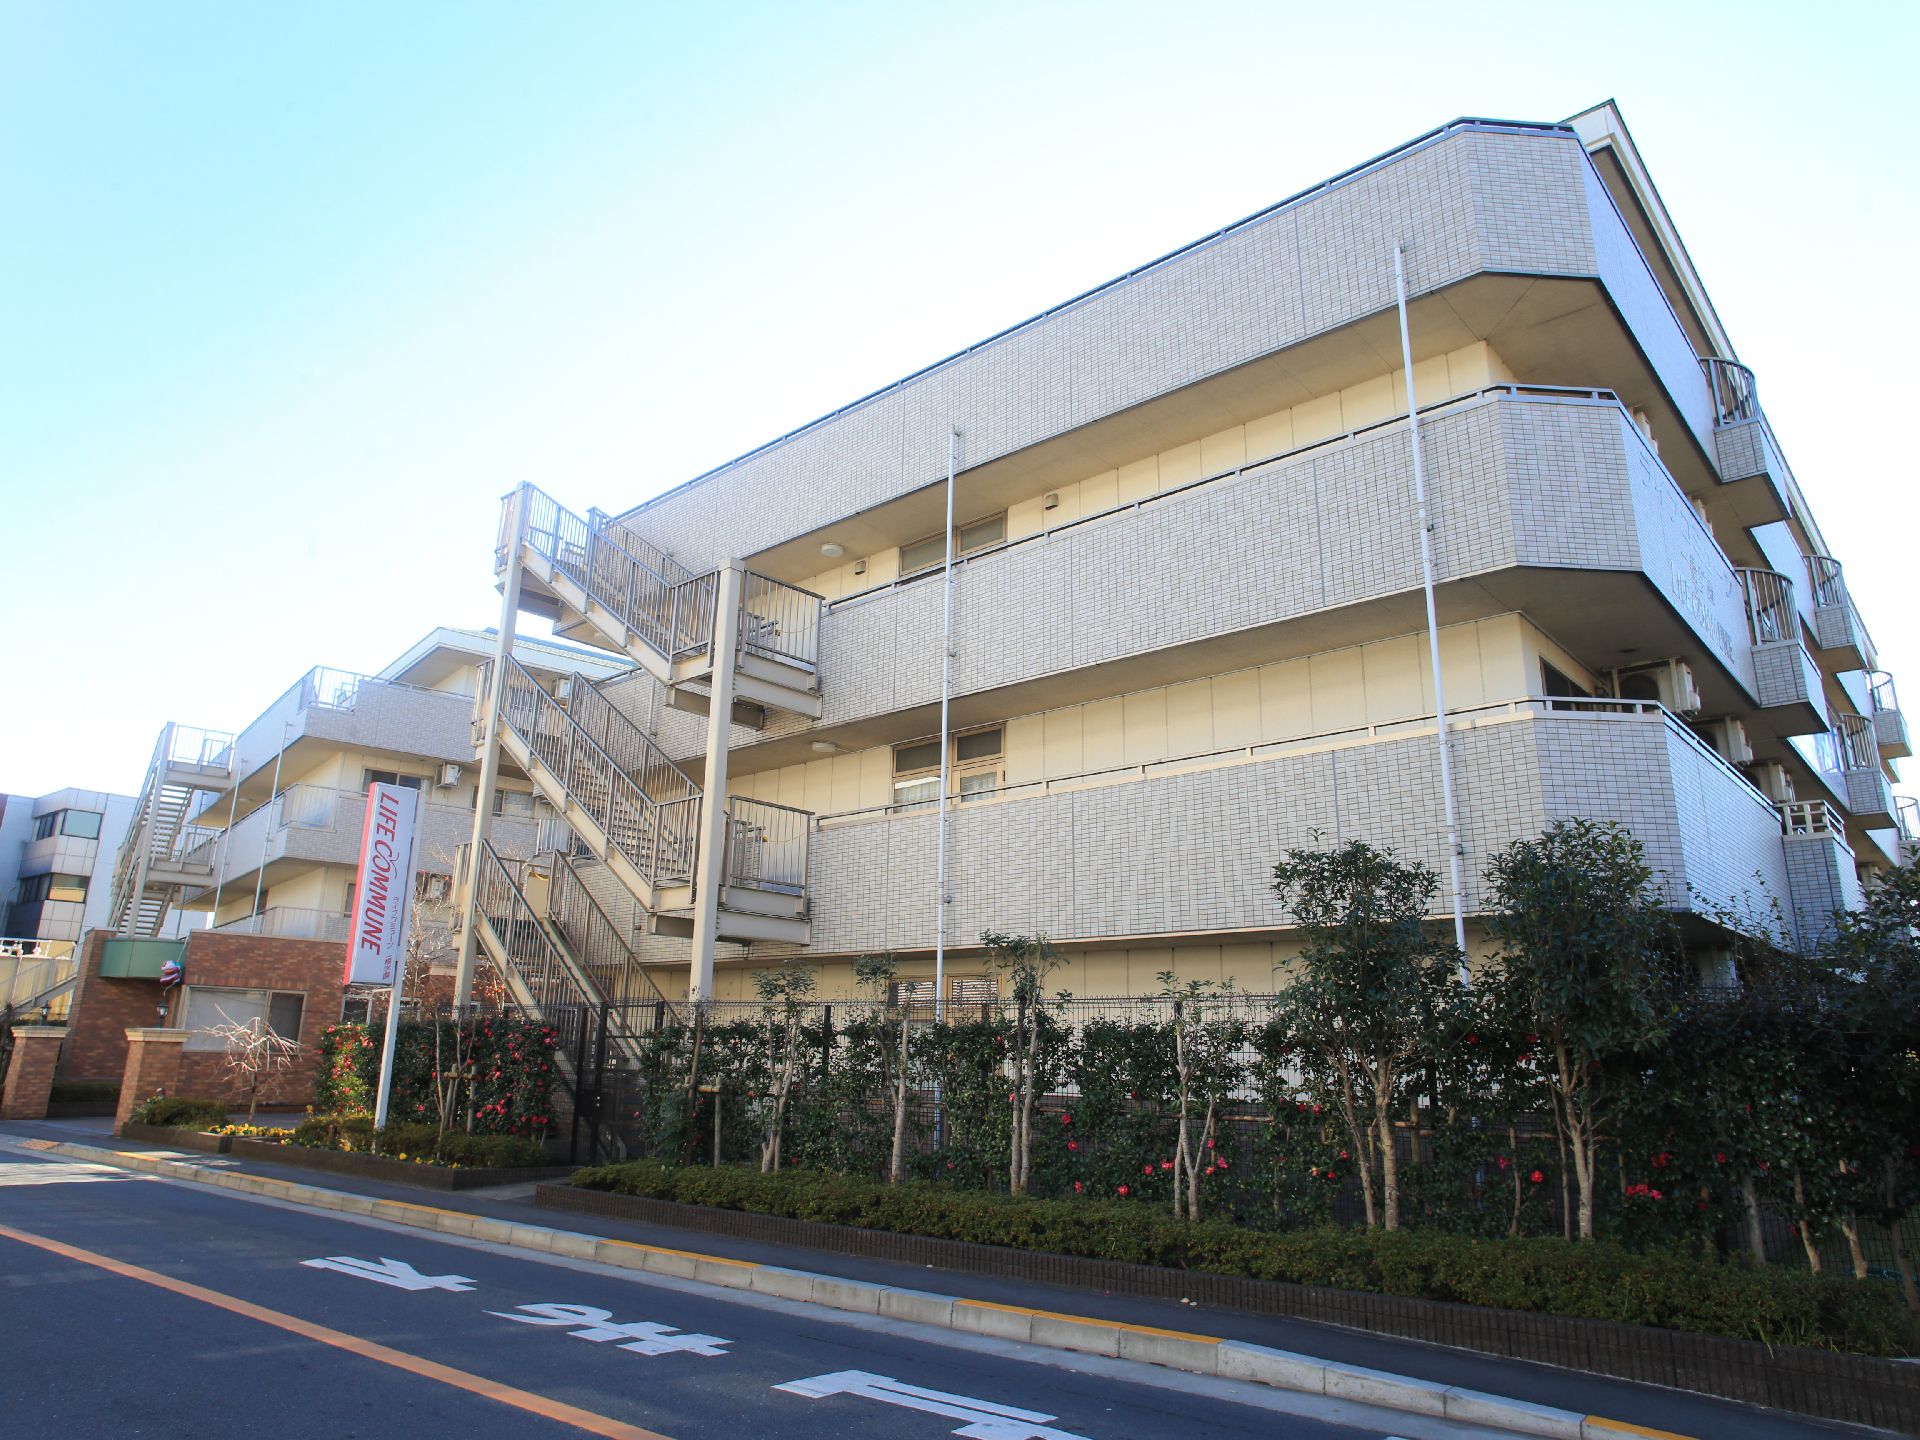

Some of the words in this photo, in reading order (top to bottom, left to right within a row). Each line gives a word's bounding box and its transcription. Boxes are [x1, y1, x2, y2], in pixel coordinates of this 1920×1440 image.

[1670, 560, 1692, 612] LIFE
[376, 791, 399, 842] LIFE
[361, 841, 396, 956] COMMUNE
